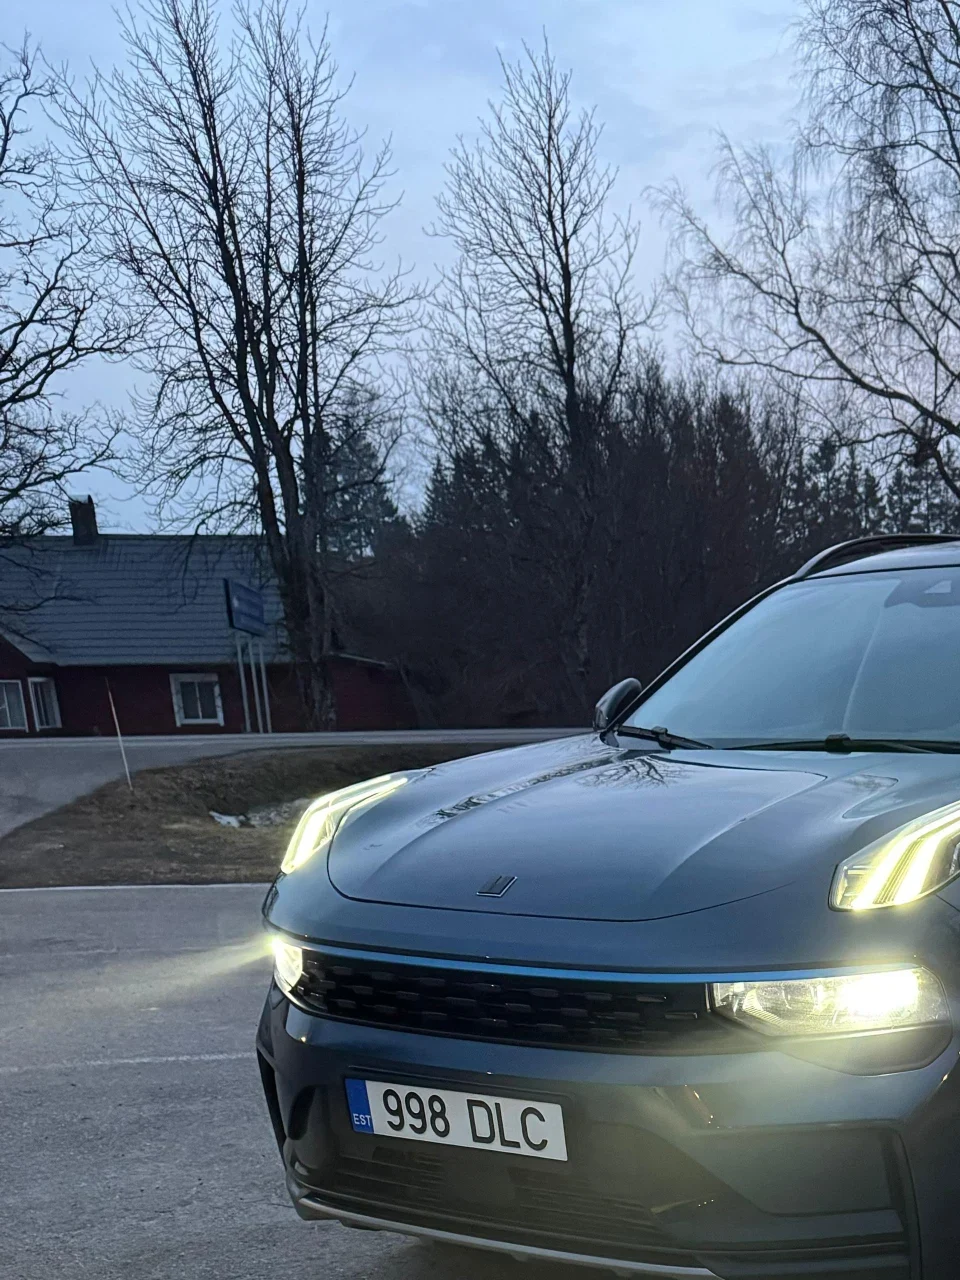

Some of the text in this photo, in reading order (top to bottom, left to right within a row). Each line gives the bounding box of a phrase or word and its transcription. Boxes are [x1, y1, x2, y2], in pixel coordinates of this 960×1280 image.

[353, 1112, 371, 1127] EST
[382, 1088, 548, 1151] 998 DLC
